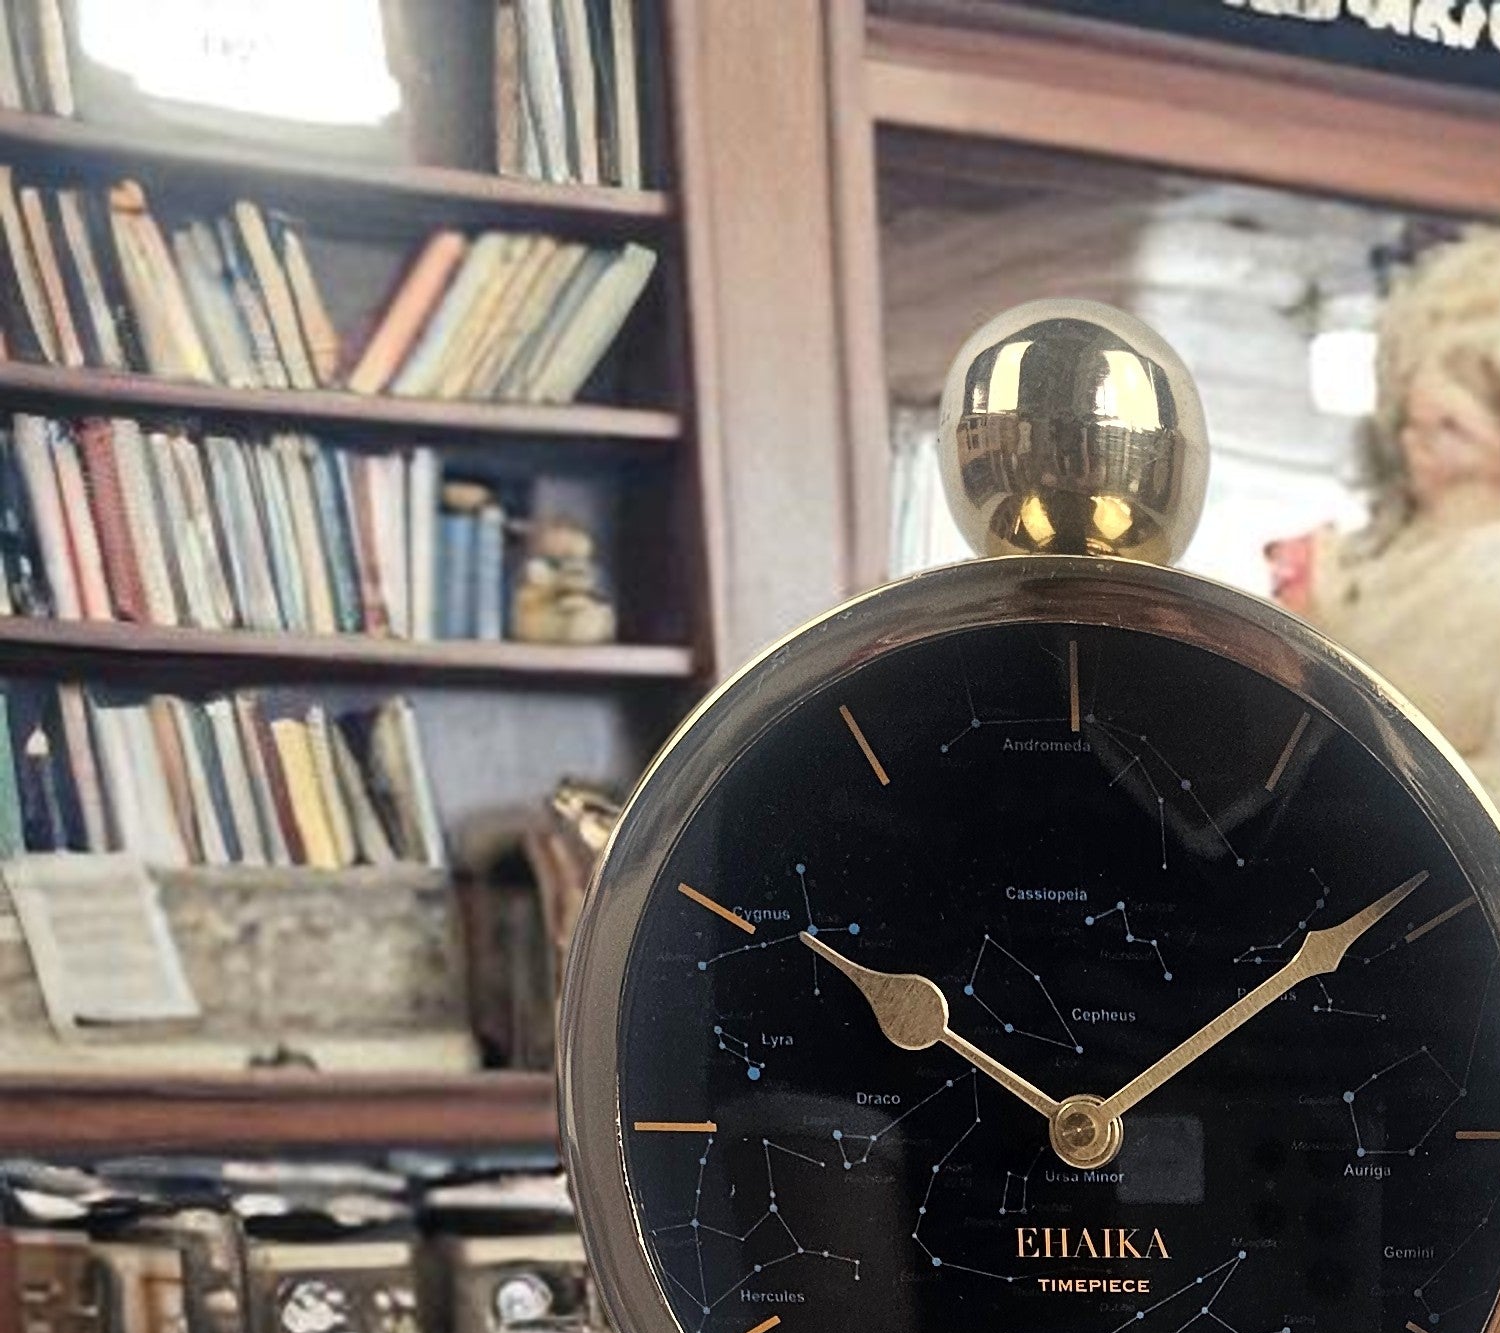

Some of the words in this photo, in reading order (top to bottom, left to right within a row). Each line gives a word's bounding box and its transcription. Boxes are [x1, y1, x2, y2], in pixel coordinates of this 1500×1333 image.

[1002, 737, 1092, 753] Andromeda
[1004, 886, 1089, 903] Cassiopeia
[733, 905, 791, 923] Cygnus
[1071, 1007, 1137, 1024] Cepheus
[761, 1031, 795, 1048] Lyra
[855, 1091, 902, 1106] Draco
[1044, 1169, 1080, 1184] Ursa
[1082, 1169, 1126, 1184] Minor
[1343, 1163, 1393, 1180] Auriga
[1014, 1226, 1174, 1260] EHAIKA
[1383, 1245, 1436, 1260] Gemini
[1037, 1277, 1151, 1294] TIMEPIECE
[739, 1288, 806, 1304] Hercules
